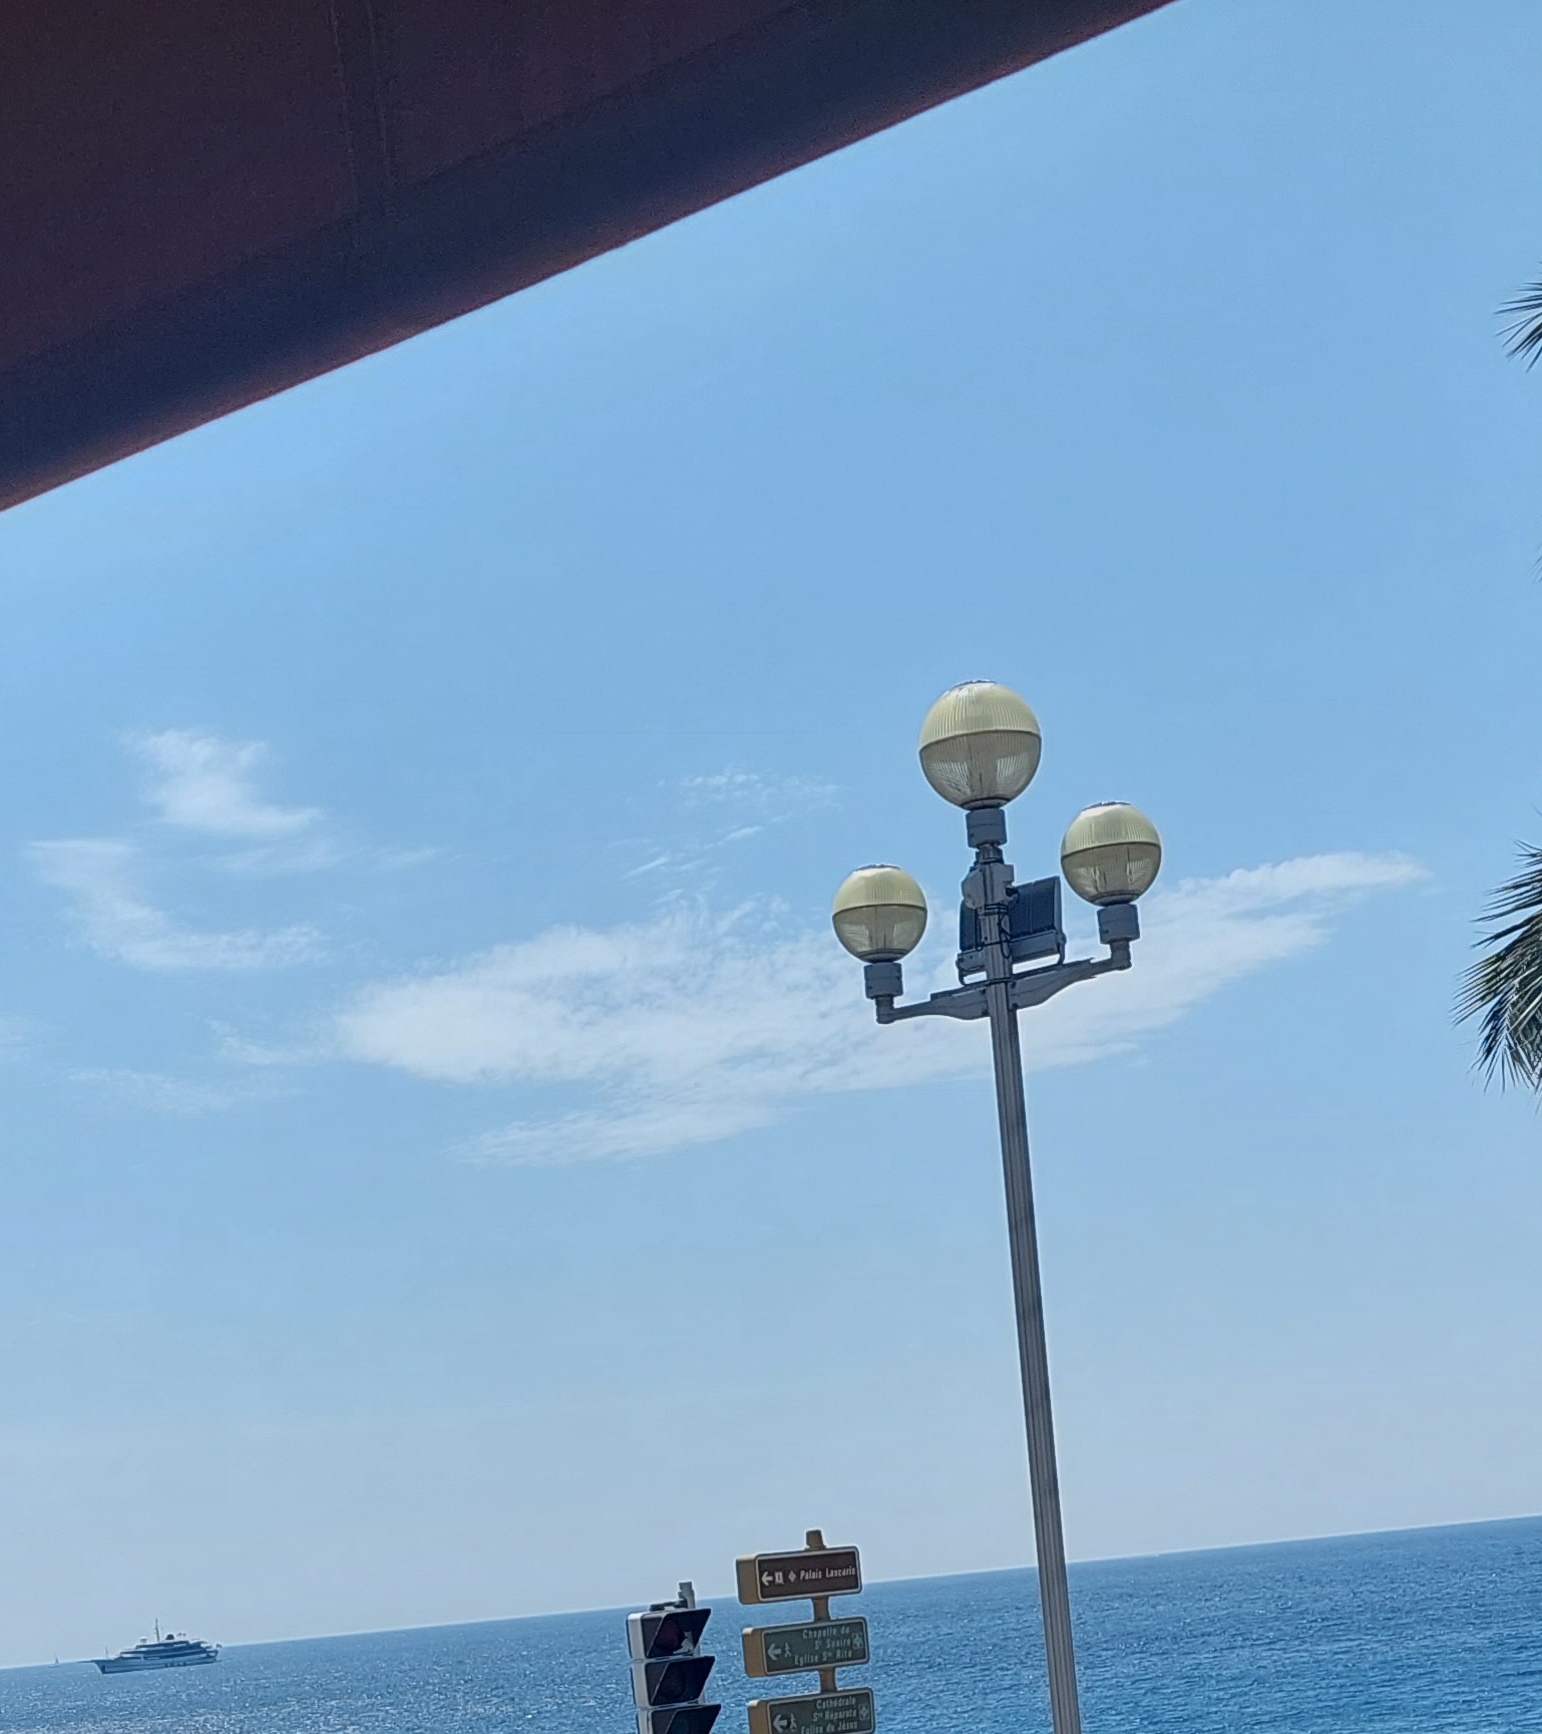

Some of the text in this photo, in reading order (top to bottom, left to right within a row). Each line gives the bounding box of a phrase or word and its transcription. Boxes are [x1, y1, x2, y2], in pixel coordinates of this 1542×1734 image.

[800, 1568, 822, 1581] Palais
[802, 1624, 850, 1640] Chapelle du
[826, 1637, 851, 1649] Suaire
[836, 1648, 852, 1660] Rita
[816, 1696, 856, 1710] Cathédrale
[837, 1720, 858, 1731] Jésus
